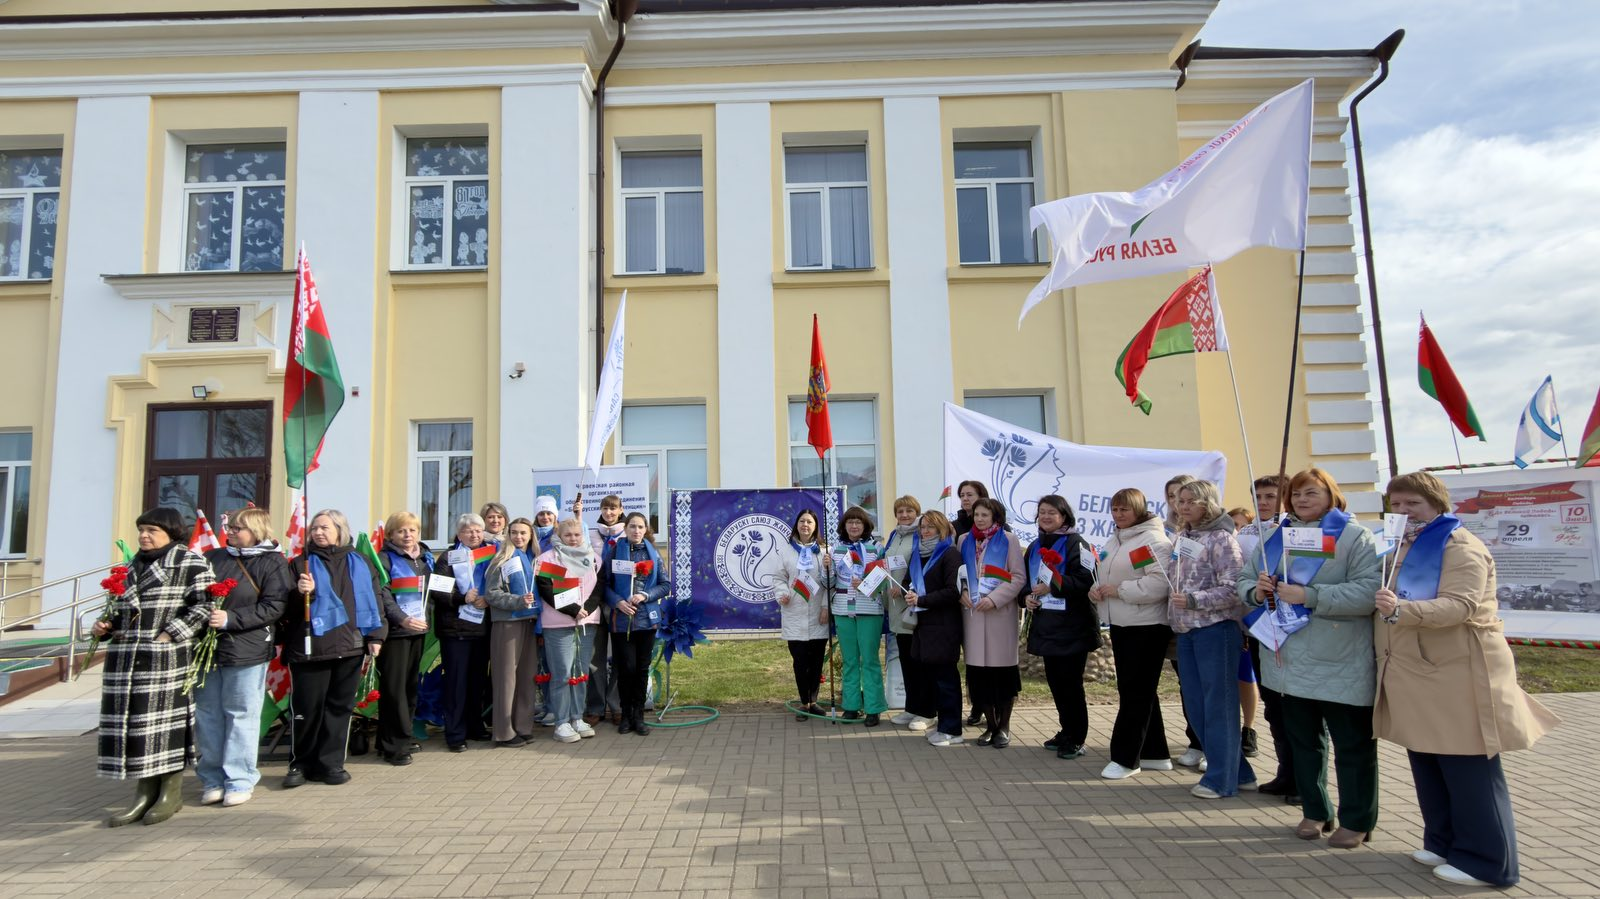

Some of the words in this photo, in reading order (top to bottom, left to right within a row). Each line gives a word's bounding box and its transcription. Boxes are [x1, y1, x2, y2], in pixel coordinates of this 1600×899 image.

[1567, 507, 1585, 516] 10
[719, 517, 750, 548] БЕЛАРУСКІ
[750, 516, 772, 524] САЮЗ
[772, 520, 792, 538] ЖАНЧ
[1506, 525, 1530, 536] 29
